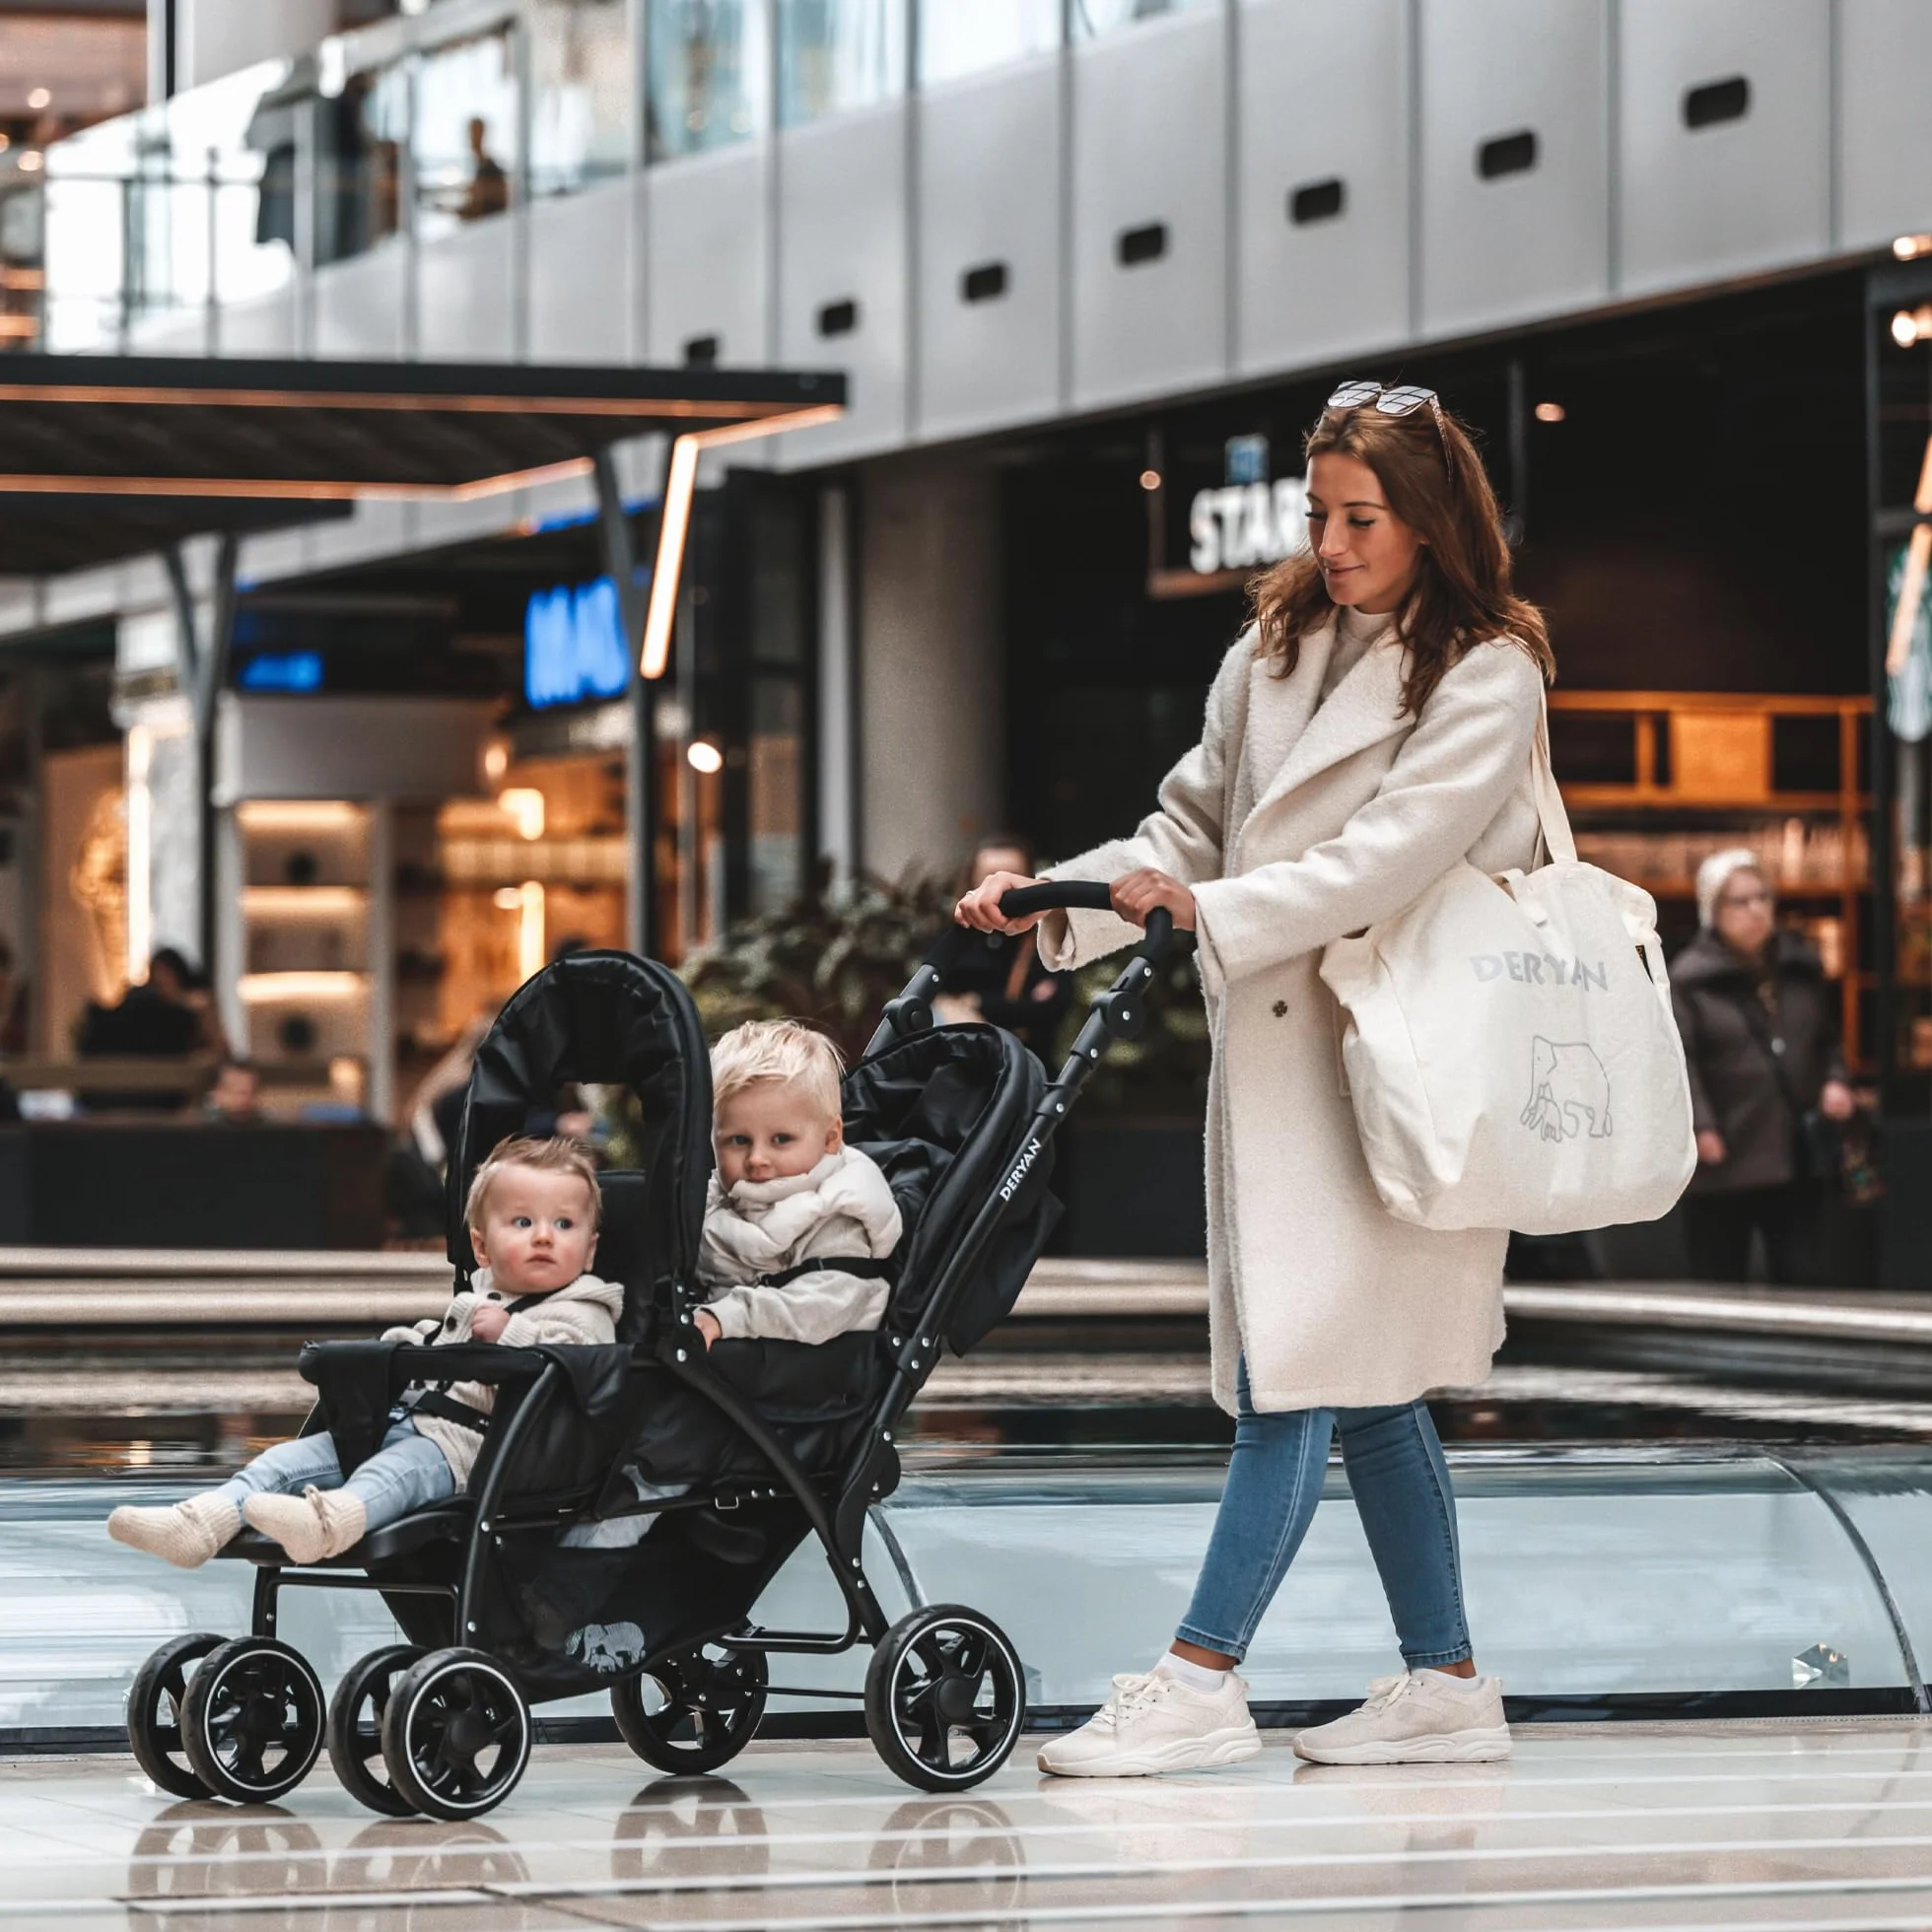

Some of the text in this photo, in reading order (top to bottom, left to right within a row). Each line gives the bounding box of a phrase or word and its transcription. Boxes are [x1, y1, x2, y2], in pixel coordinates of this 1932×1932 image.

[1191, 479, 1310, 573] STAR
[1469, 951, 1609, 993] DERYAN
[999, 1137, 1042, 1202] DERYAN
